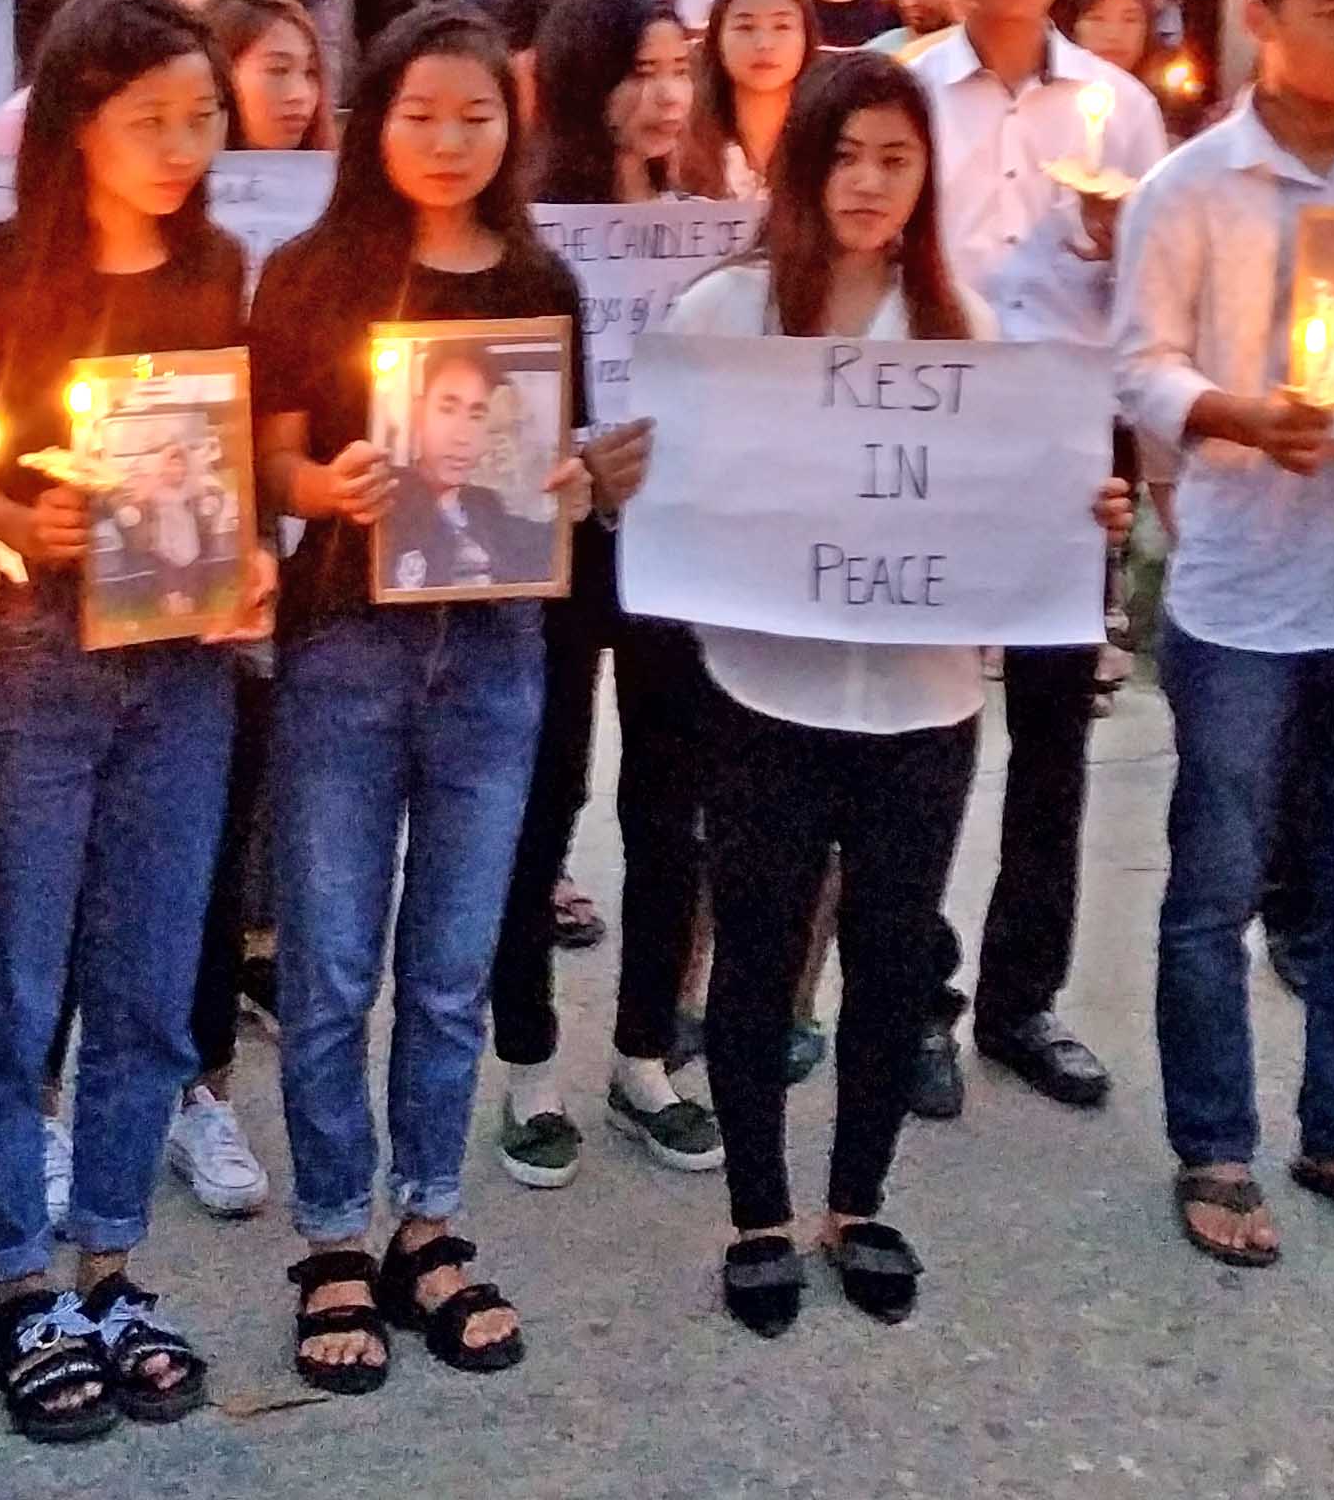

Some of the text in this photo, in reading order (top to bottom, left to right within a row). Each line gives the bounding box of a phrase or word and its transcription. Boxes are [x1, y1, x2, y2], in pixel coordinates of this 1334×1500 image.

[533, 222, 599, 262] THE
[605, 219, 707, 260] CANDLE
[822, 344, 977, 414] REST
[856, 443, 928, 500] IN
[810, 542, 948, 607] PEACE
